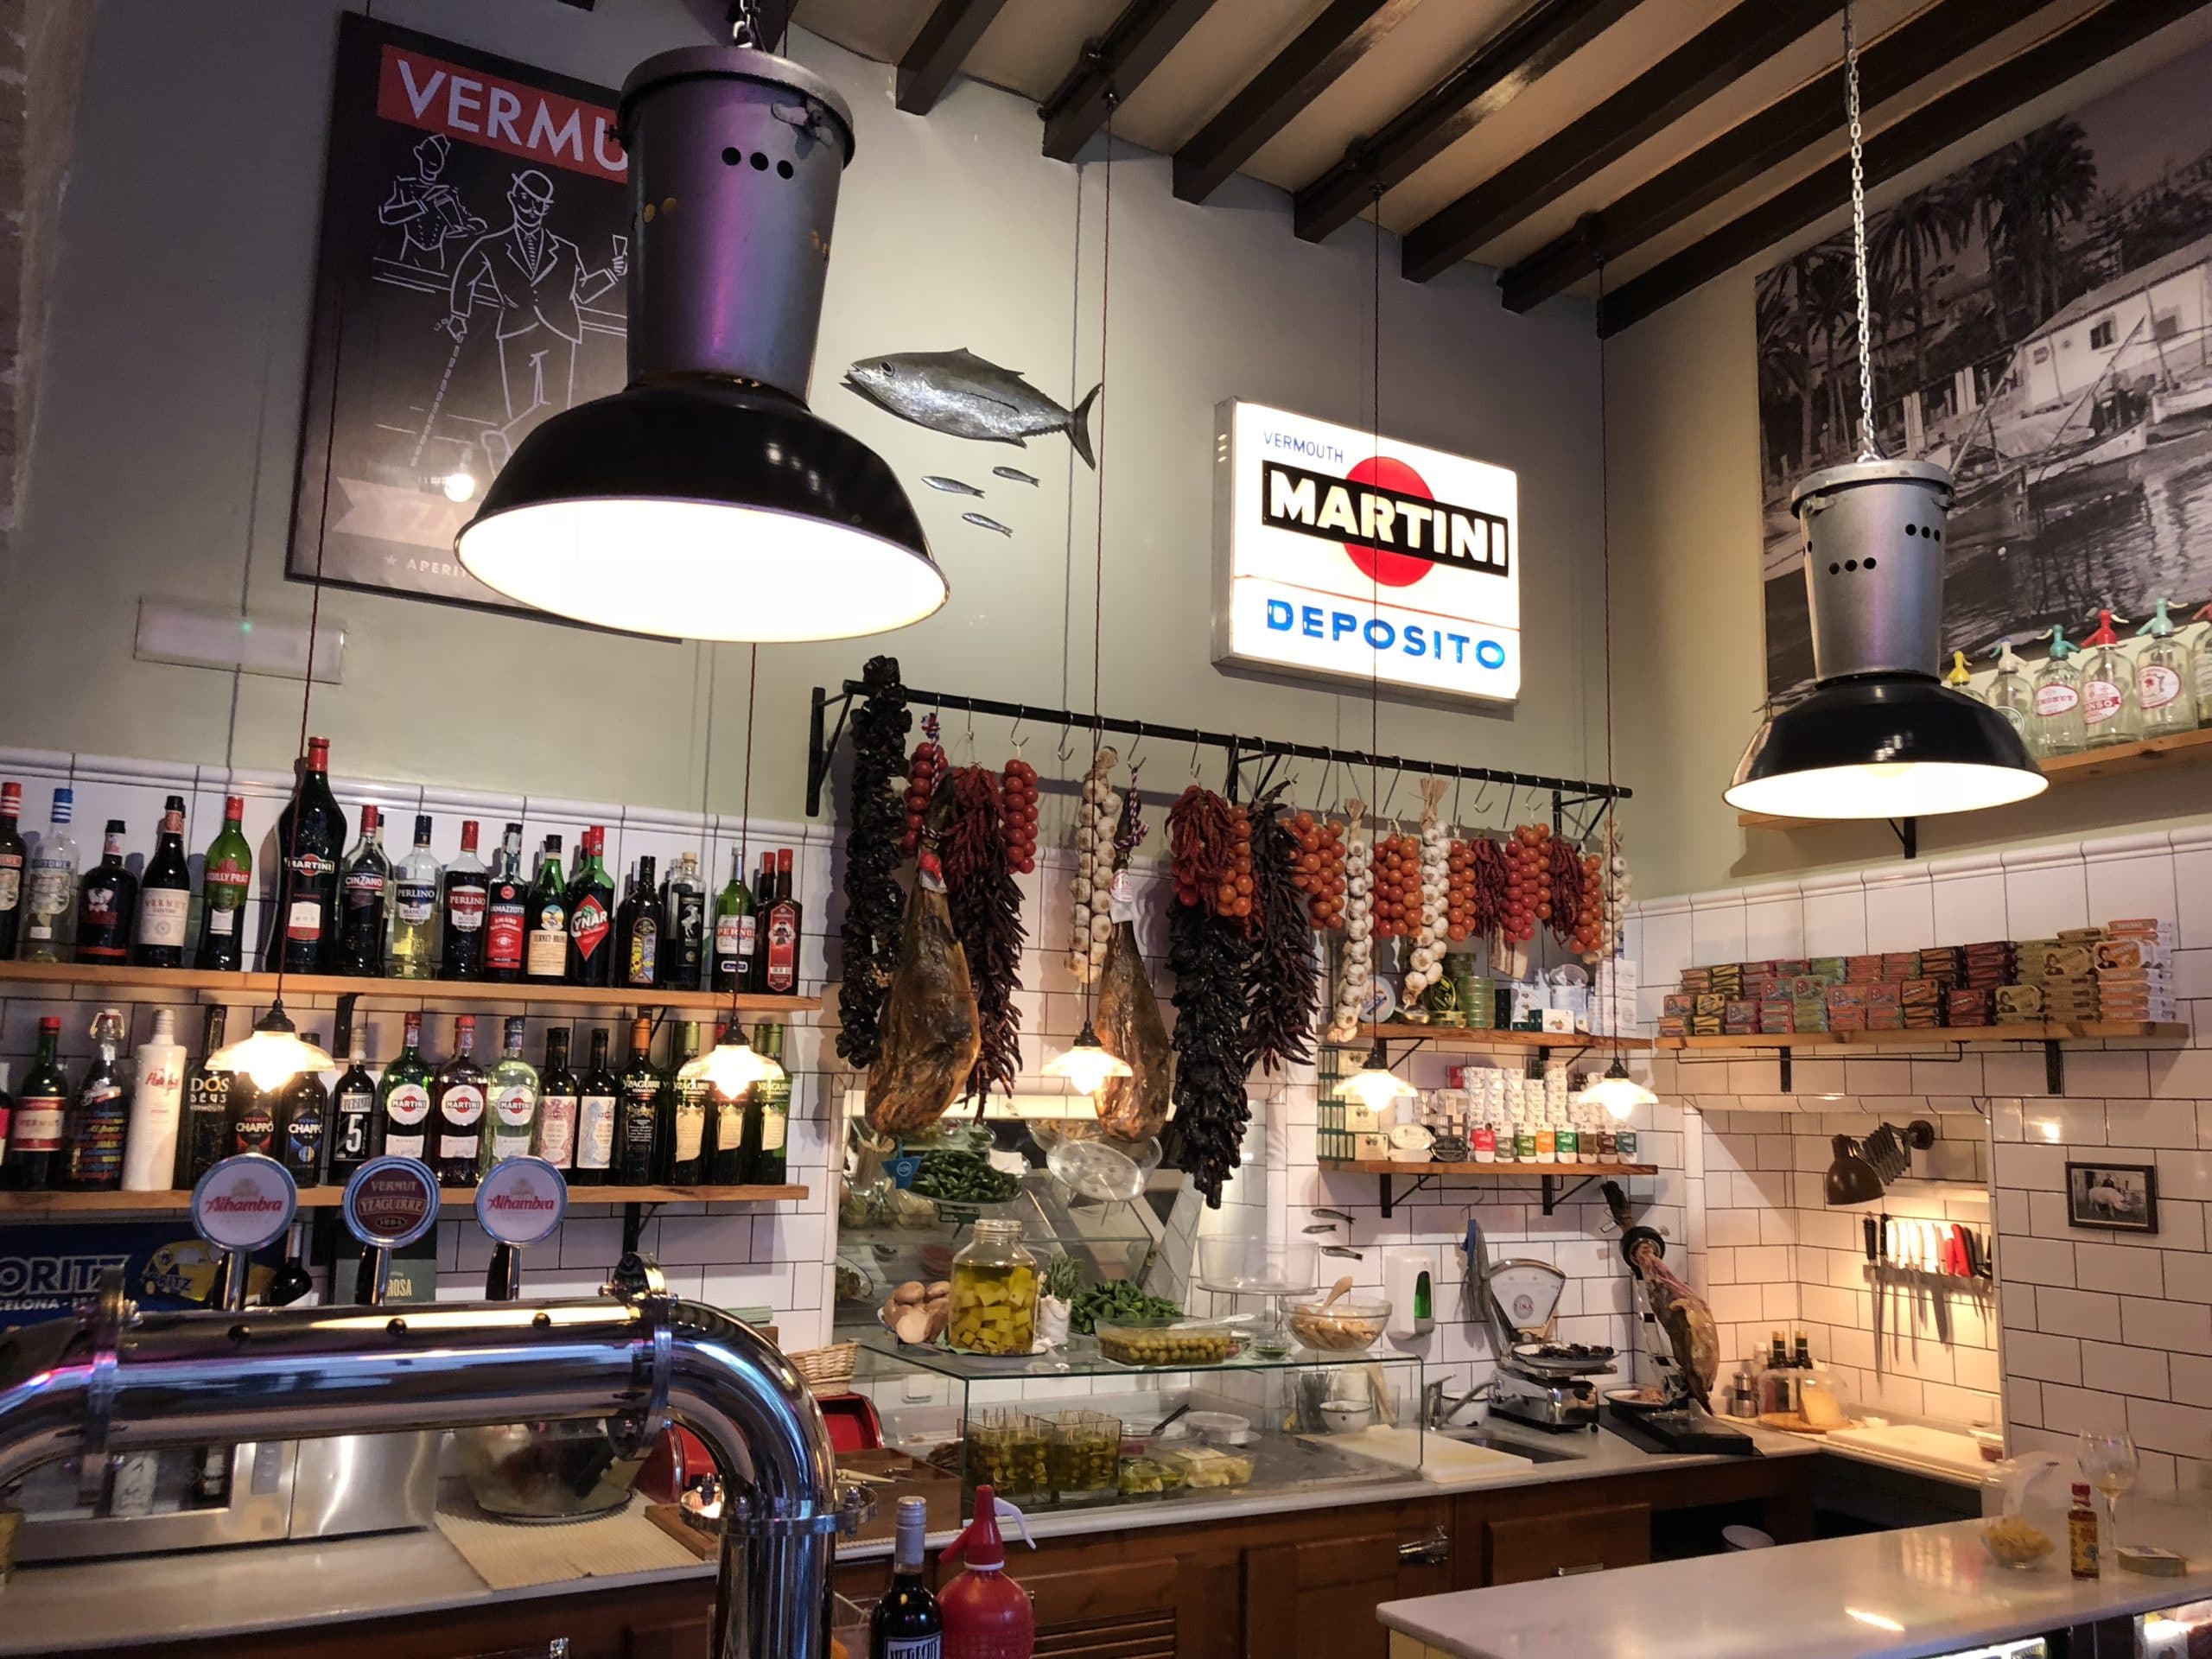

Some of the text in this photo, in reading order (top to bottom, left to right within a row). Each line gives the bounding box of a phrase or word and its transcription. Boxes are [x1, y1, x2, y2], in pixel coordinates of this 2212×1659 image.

[1264, 430, 1344, 463] VERMOUTH
[1270, 469, 1506, 567] MARTINI
[1267, 598, 1505, 670] DEPOSITO
[287, 860, 332, 871] MARTINI
[346, 876, 383, 887] CINZANO
[397, 888, 435, 899] PERLINO
[450, 895, 486, 906] PERLINO
[570, 911, 608, 938] CYNAR
[190, 1077, 230, 1093] DOS
[391, 1099, 425, 1109] MARTINI
[445, 1100, 480, 1109] MARTINI
[499, 1101, 532, 1110] MARTINI
[346, 1114, 364, 1153] 5
[371, 1180, 416, 1192] VERMUT
[205, 1195, 283, 1214] Alhambra
[486, 1194, 555, 1211] Alhambra
